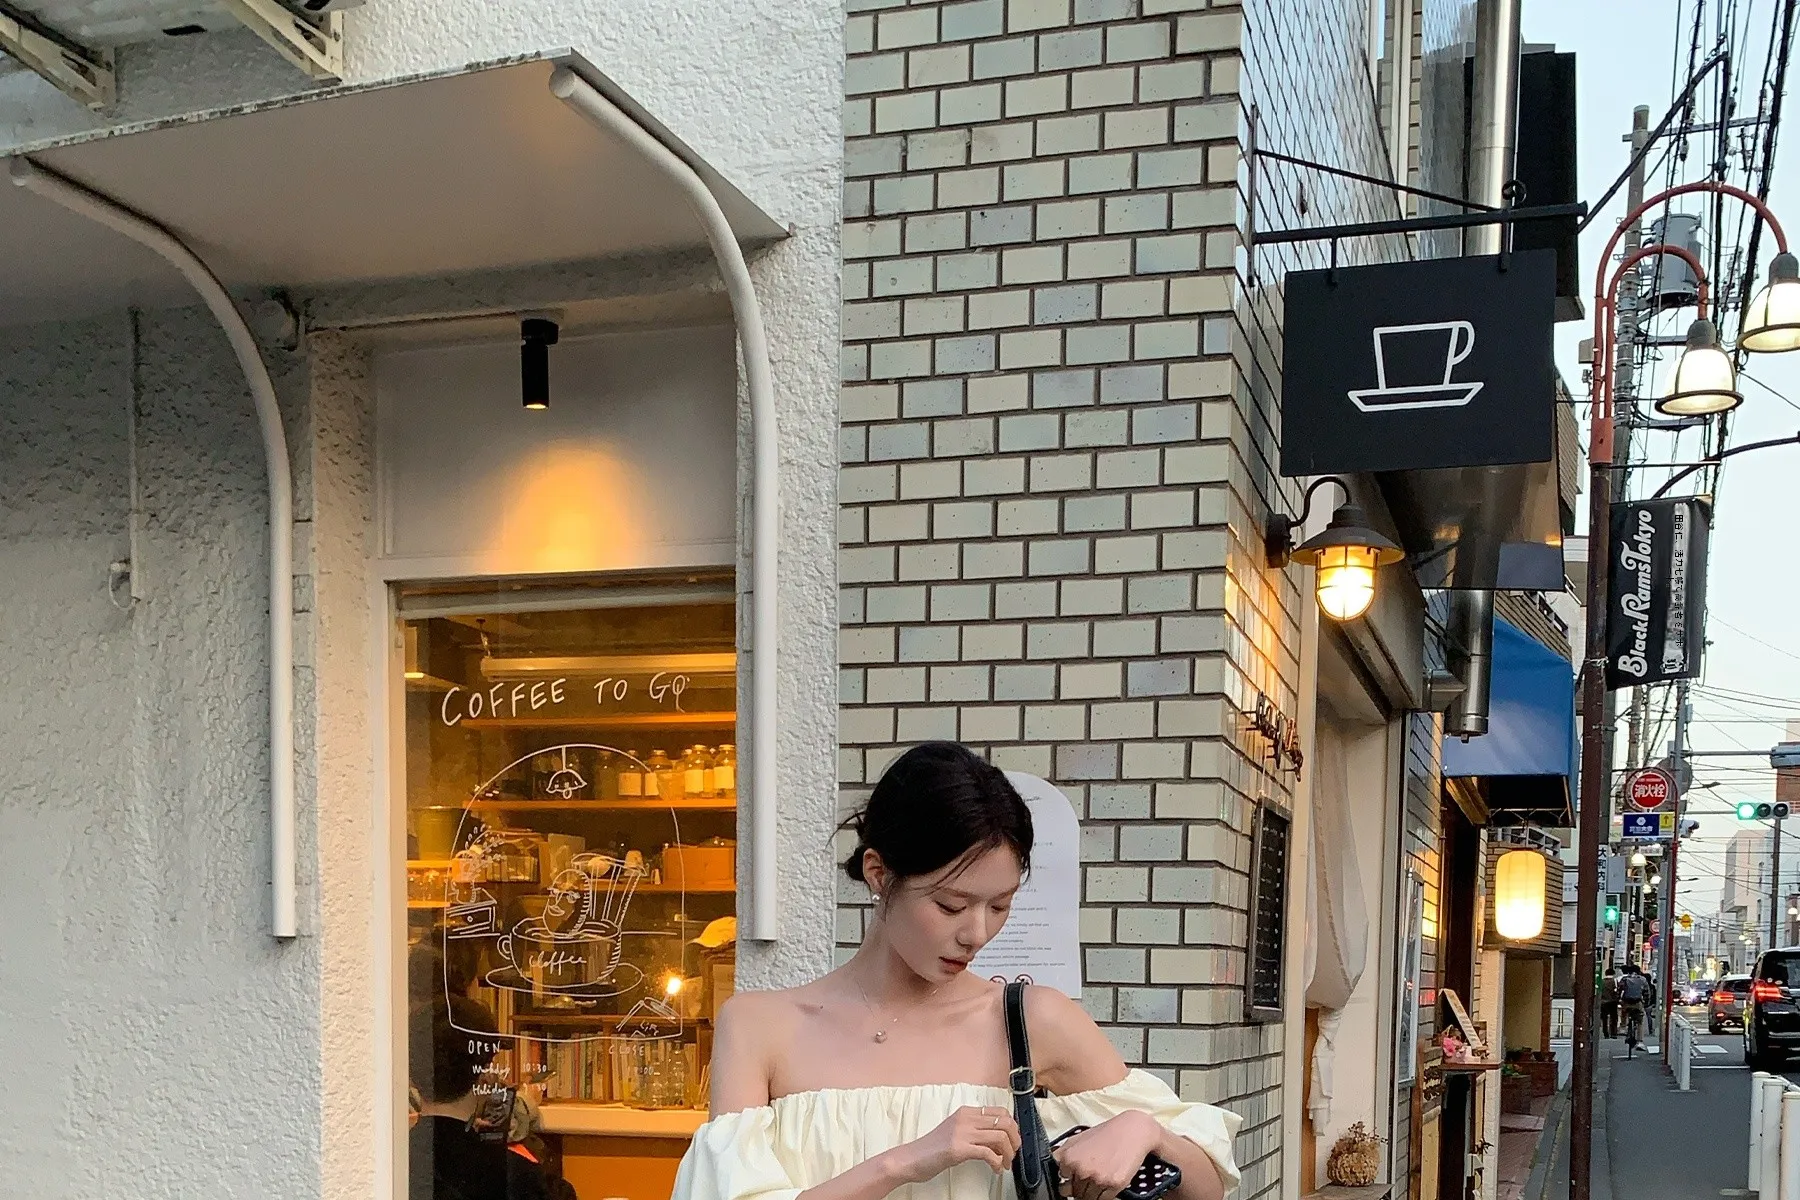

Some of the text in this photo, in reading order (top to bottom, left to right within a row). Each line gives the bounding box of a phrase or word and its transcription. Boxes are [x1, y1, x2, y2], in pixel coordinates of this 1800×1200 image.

[441, 677, 567, 726] COFFEE
[593, 677, 628, 705] TO
[1634, 784, 1665, 798] 消火栓
[468, 1039, 501, 1055] OPEN
[523, 1062, 547, 1074] 10:30
[472, 1082, 508, 1102] Holiday
